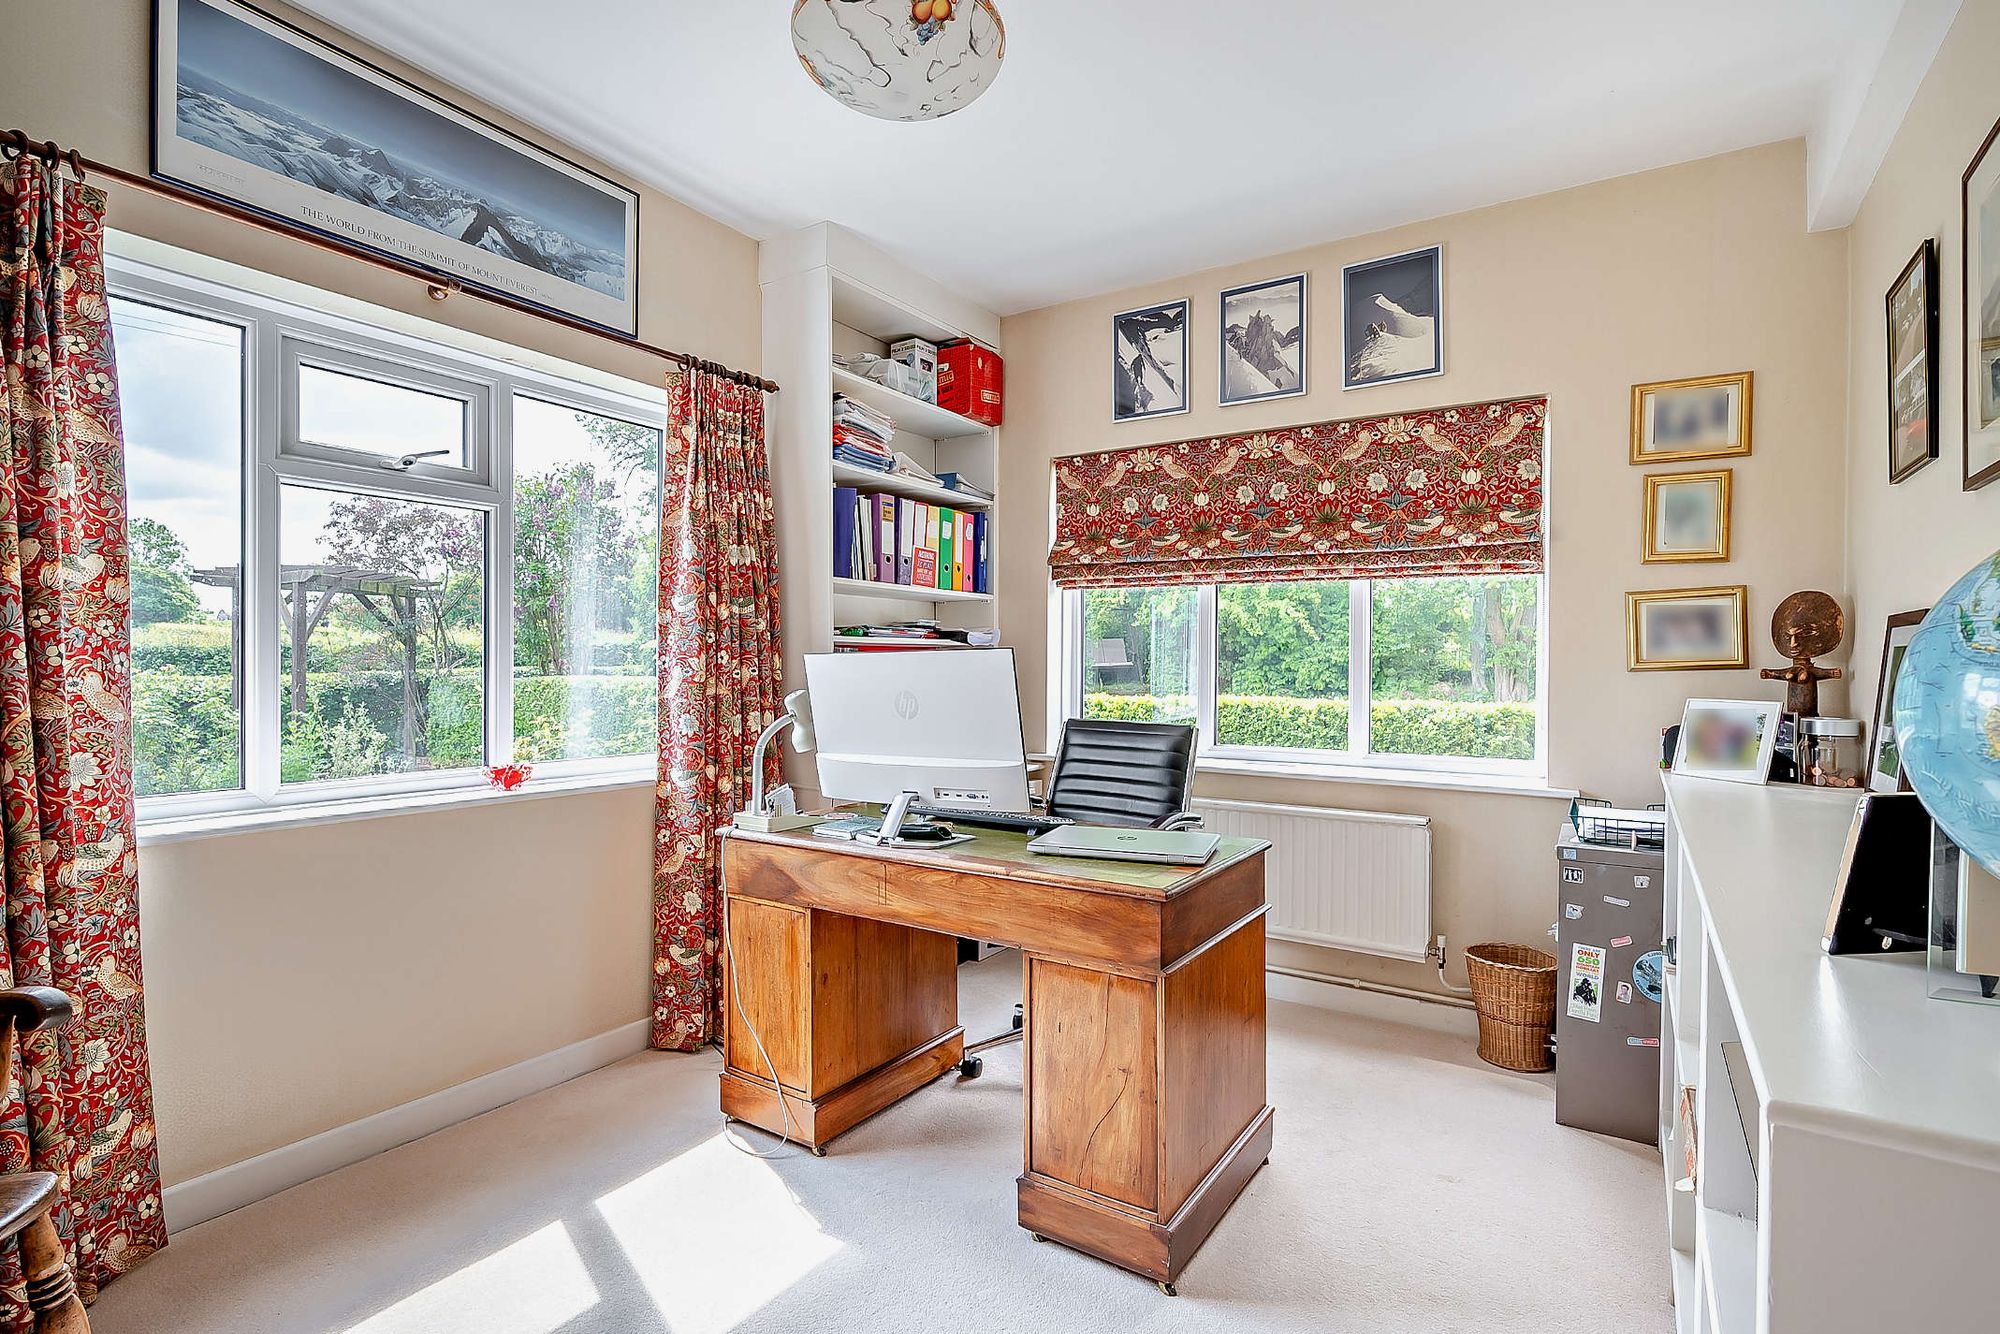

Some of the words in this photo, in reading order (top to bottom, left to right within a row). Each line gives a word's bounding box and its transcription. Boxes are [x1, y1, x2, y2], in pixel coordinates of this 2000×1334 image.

[301, 205, 324, 221] THE
[326, 214, 365, 235] WORLD
[367, 229, 396, 246] FROM
[398, 240, 418, 254] THE
[419, 247, 456, 267] SUMMIT
[458, 260, 470, 272] OF
[472, 266, 504, 283] MOUNT
[505, 277, 539, 295] EVEREST
[1577, 949, 1600, 959] ONLY
[1577, 956, 1600, 966] 650
[1575, 972, 1599, 980] WORLD
